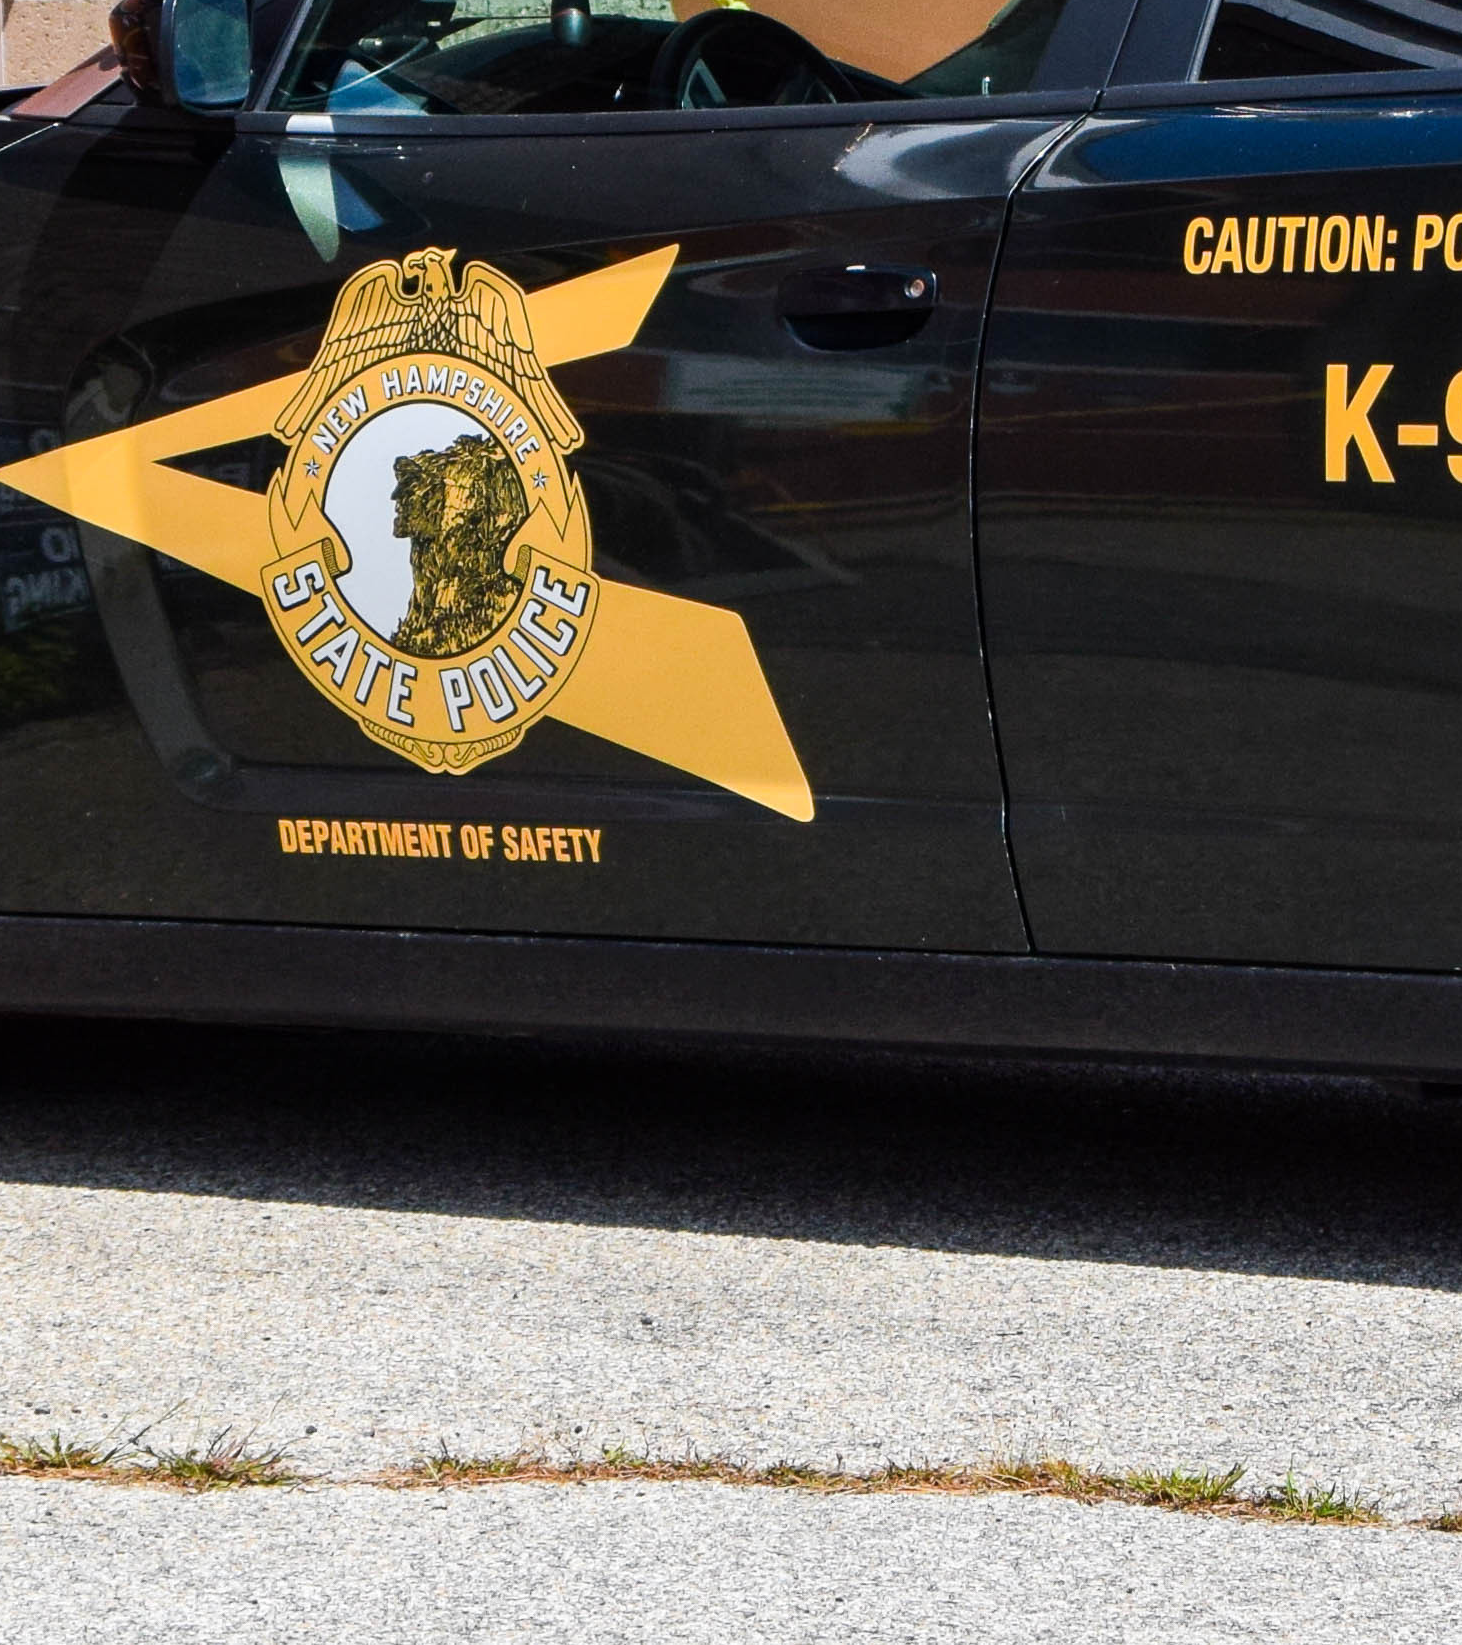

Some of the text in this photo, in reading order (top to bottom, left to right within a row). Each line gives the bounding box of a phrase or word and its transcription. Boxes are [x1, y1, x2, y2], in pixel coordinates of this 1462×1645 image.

[1183, 215, 1398, 275] CAUTION:
[311, 364, 540, 463] NEW HAMPSHIRE
[273, 562, 417, 727] STATE
[440, 566, 590, 733] POLICE
[278, 819, 601, 863] DEPARTMENT OF SAFETY
